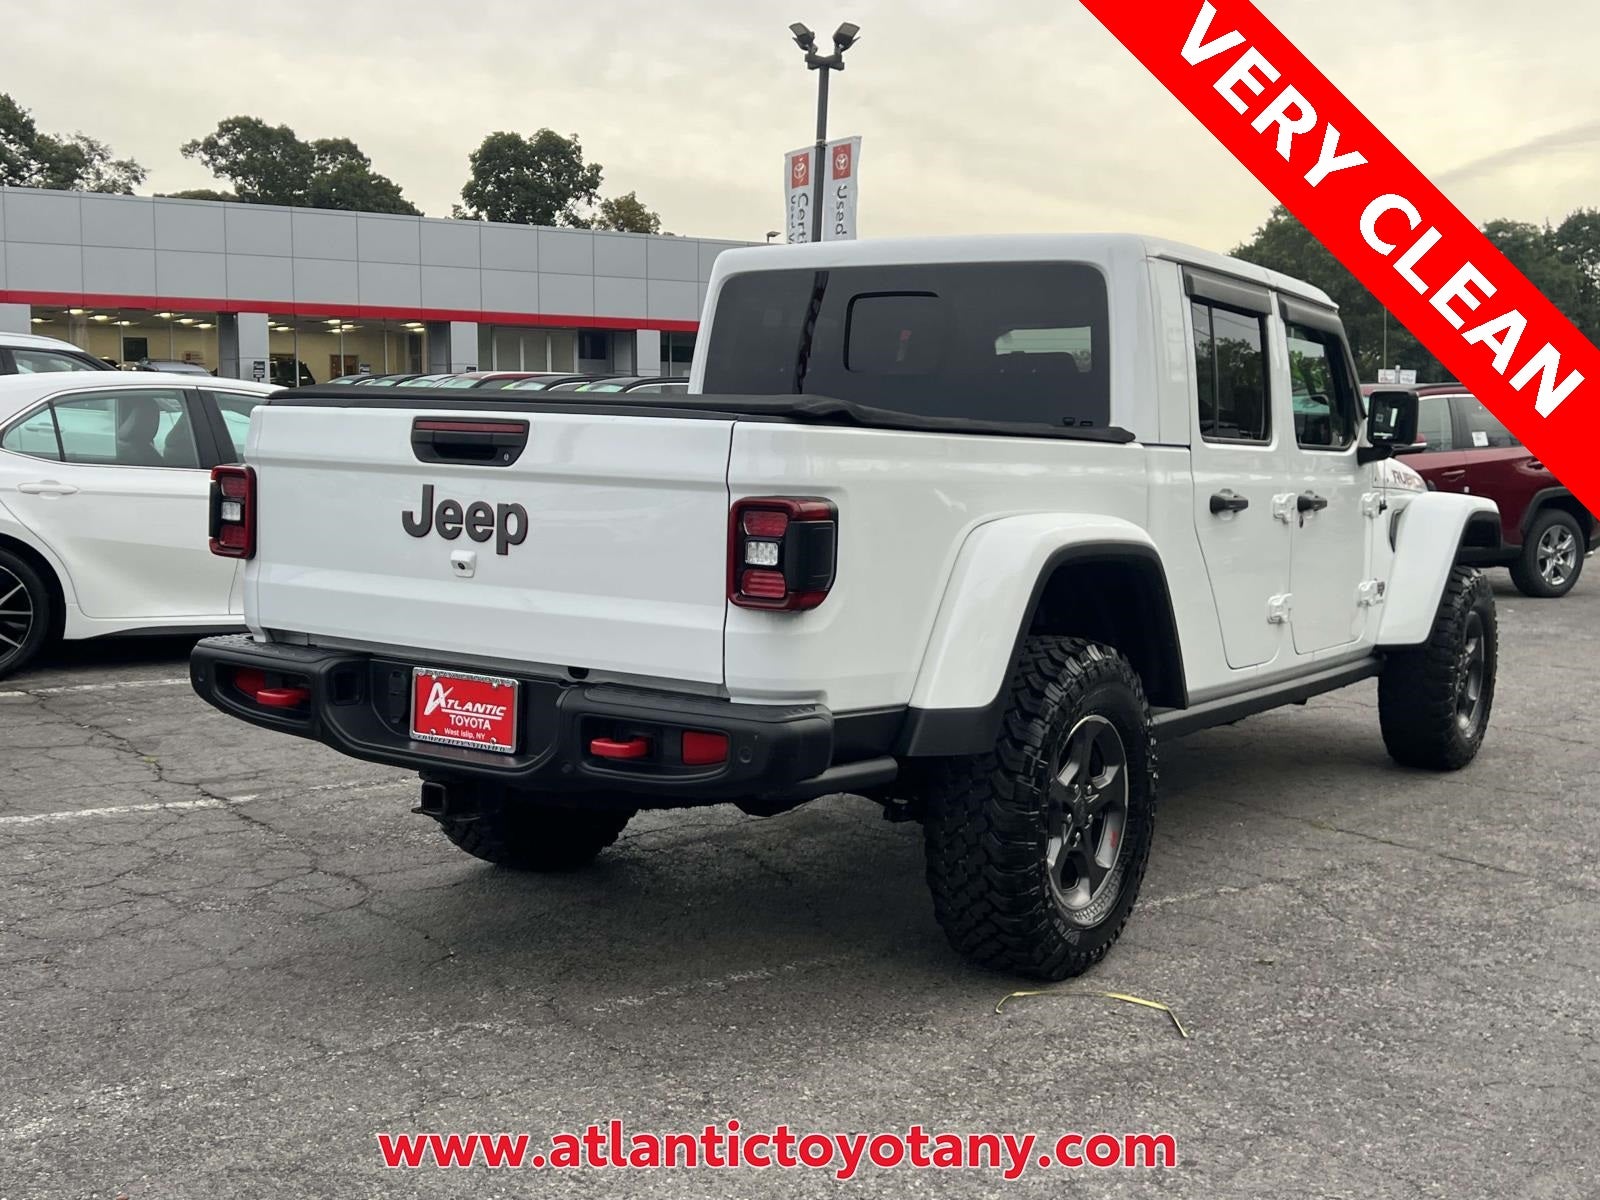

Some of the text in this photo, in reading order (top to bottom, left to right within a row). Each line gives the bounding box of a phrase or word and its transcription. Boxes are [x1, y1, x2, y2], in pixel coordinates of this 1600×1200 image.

[836, 185, 847, 235] Used
[402, 485, 528, 555] Jeep
[444, 728, 486, 740] West Islip, NY
[449, 714, 491, 730] TOYOTA
